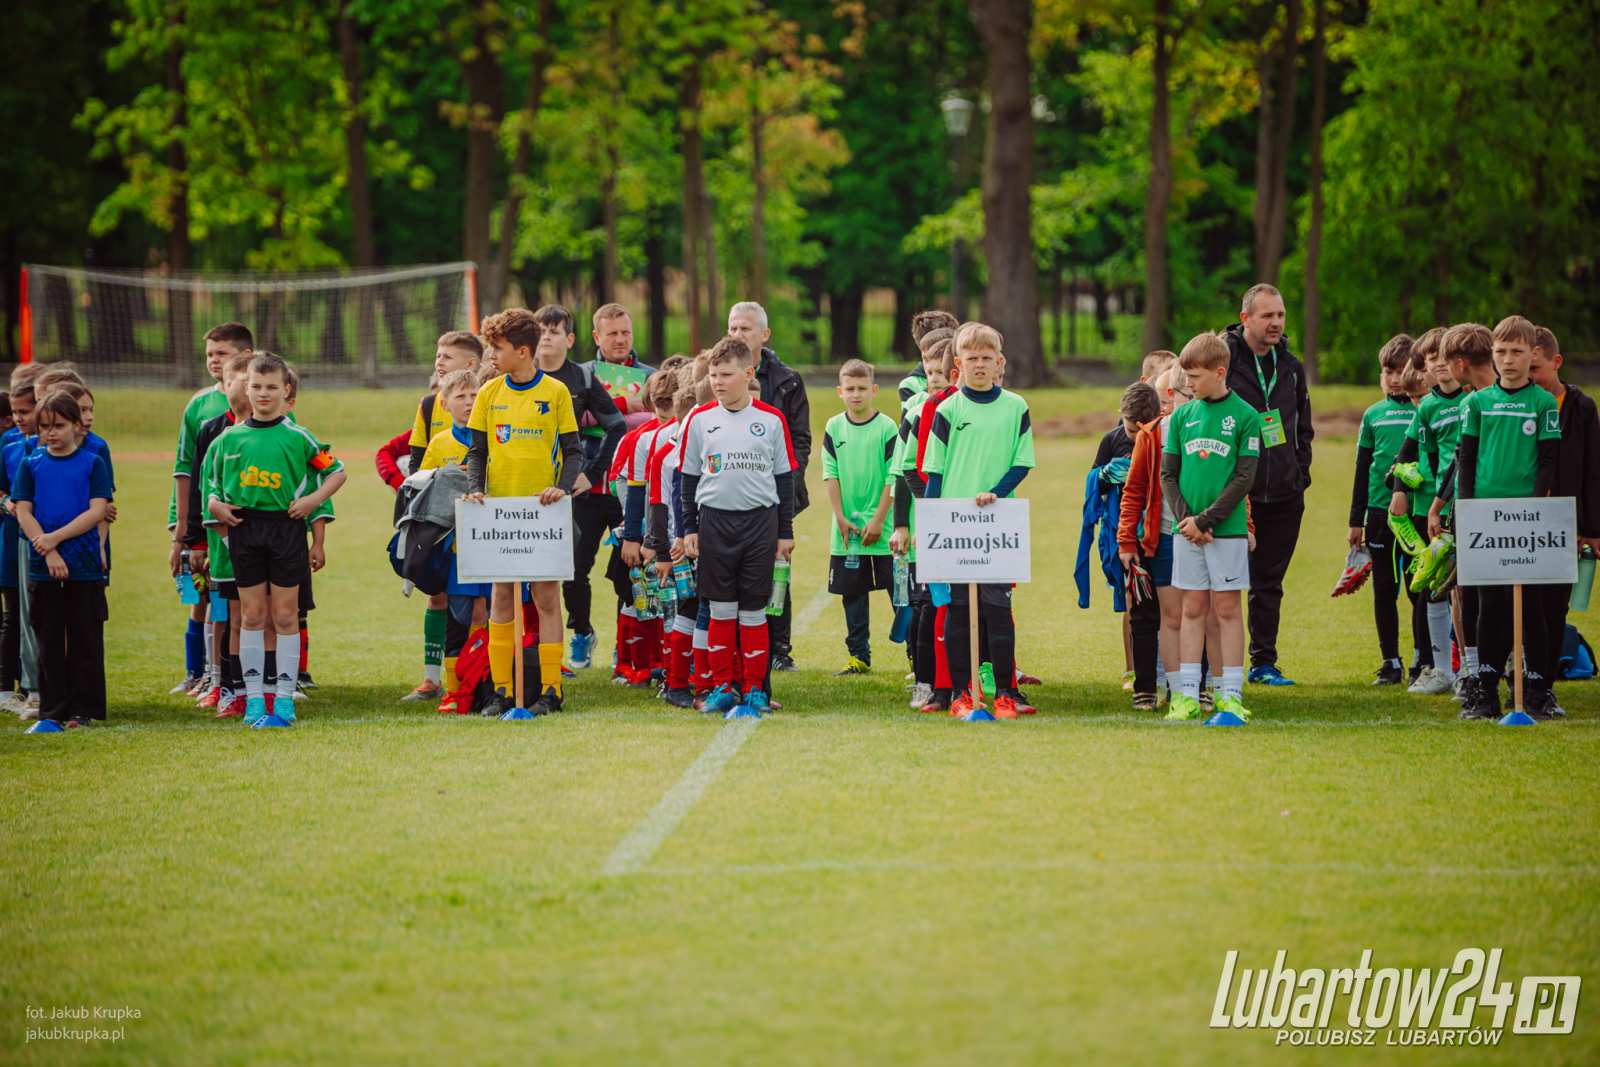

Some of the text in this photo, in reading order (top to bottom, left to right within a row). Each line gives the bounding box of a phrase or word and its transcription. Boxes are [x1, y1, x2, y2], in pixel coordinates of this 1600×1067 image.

[727, 452, 762, 461] POWIAT
[724, 462, 766, 472] ZAMOJSKI
[495, 508, 540, 520] Powiat
[951, 511, 996, 523] Powiat
[1494, 509, 1541, 522] Powiat
[471, 527, 563, 540] Lubartowski
[927, 532, 1020, 554] Zamojski
[1469, 531, 1567, 553] Zamojski
[499, 546, 536, 554] /ziemski/
[1499, 556, 1537, 566] /grodzki/
